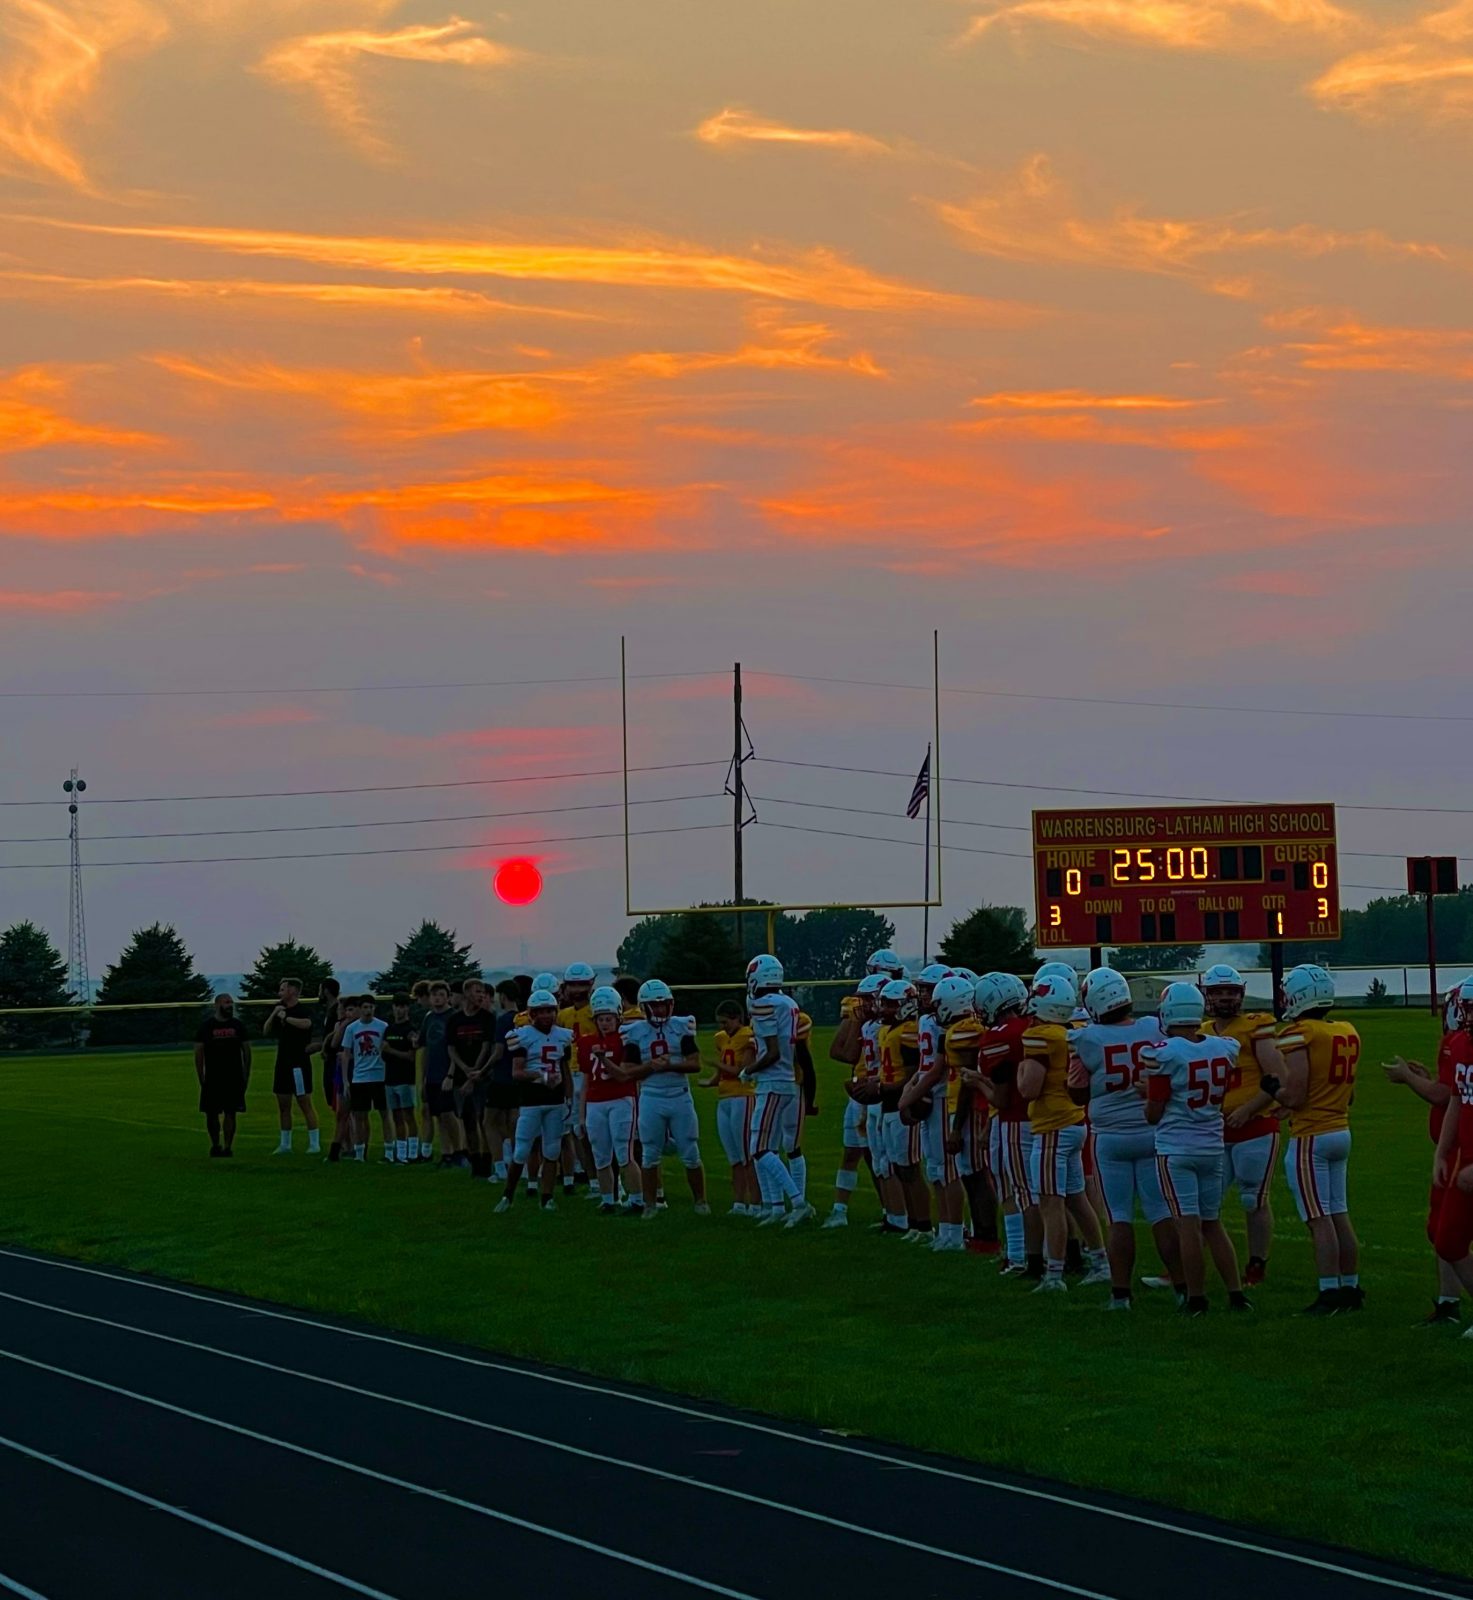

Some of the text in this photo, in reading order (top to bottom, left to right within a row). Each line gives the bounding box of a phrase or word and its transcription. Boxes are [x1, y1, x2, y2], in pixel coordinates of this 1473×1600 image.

[1229, 814, 1264, 833] HIGH
[1269, 812, 1330, 832] SCHOOL
[1047, 850, 1096, 868] HOME
[1274, 844, 1328, 862] GUEST
[1066, 869, 1081, 895] 0
[1312, 862, 1328, 889] 0
[1084, 899, 1122, 914] DOWN
[1139, 898, 1176, 913] TO GO
[1198, 896, 1243, 911] BALL ON
[1262, 895, 1286, 910] QTR
[1317, 897, 1329, 918] 3
[1050, 905, 1062, 926] 3
[1277, 911, 1284, 935] 1
[541, 1045, 557, 1074] 5
[1328, 1035, 1360, 1084] 62
[1187, 1057, 1230, 1109] 59
